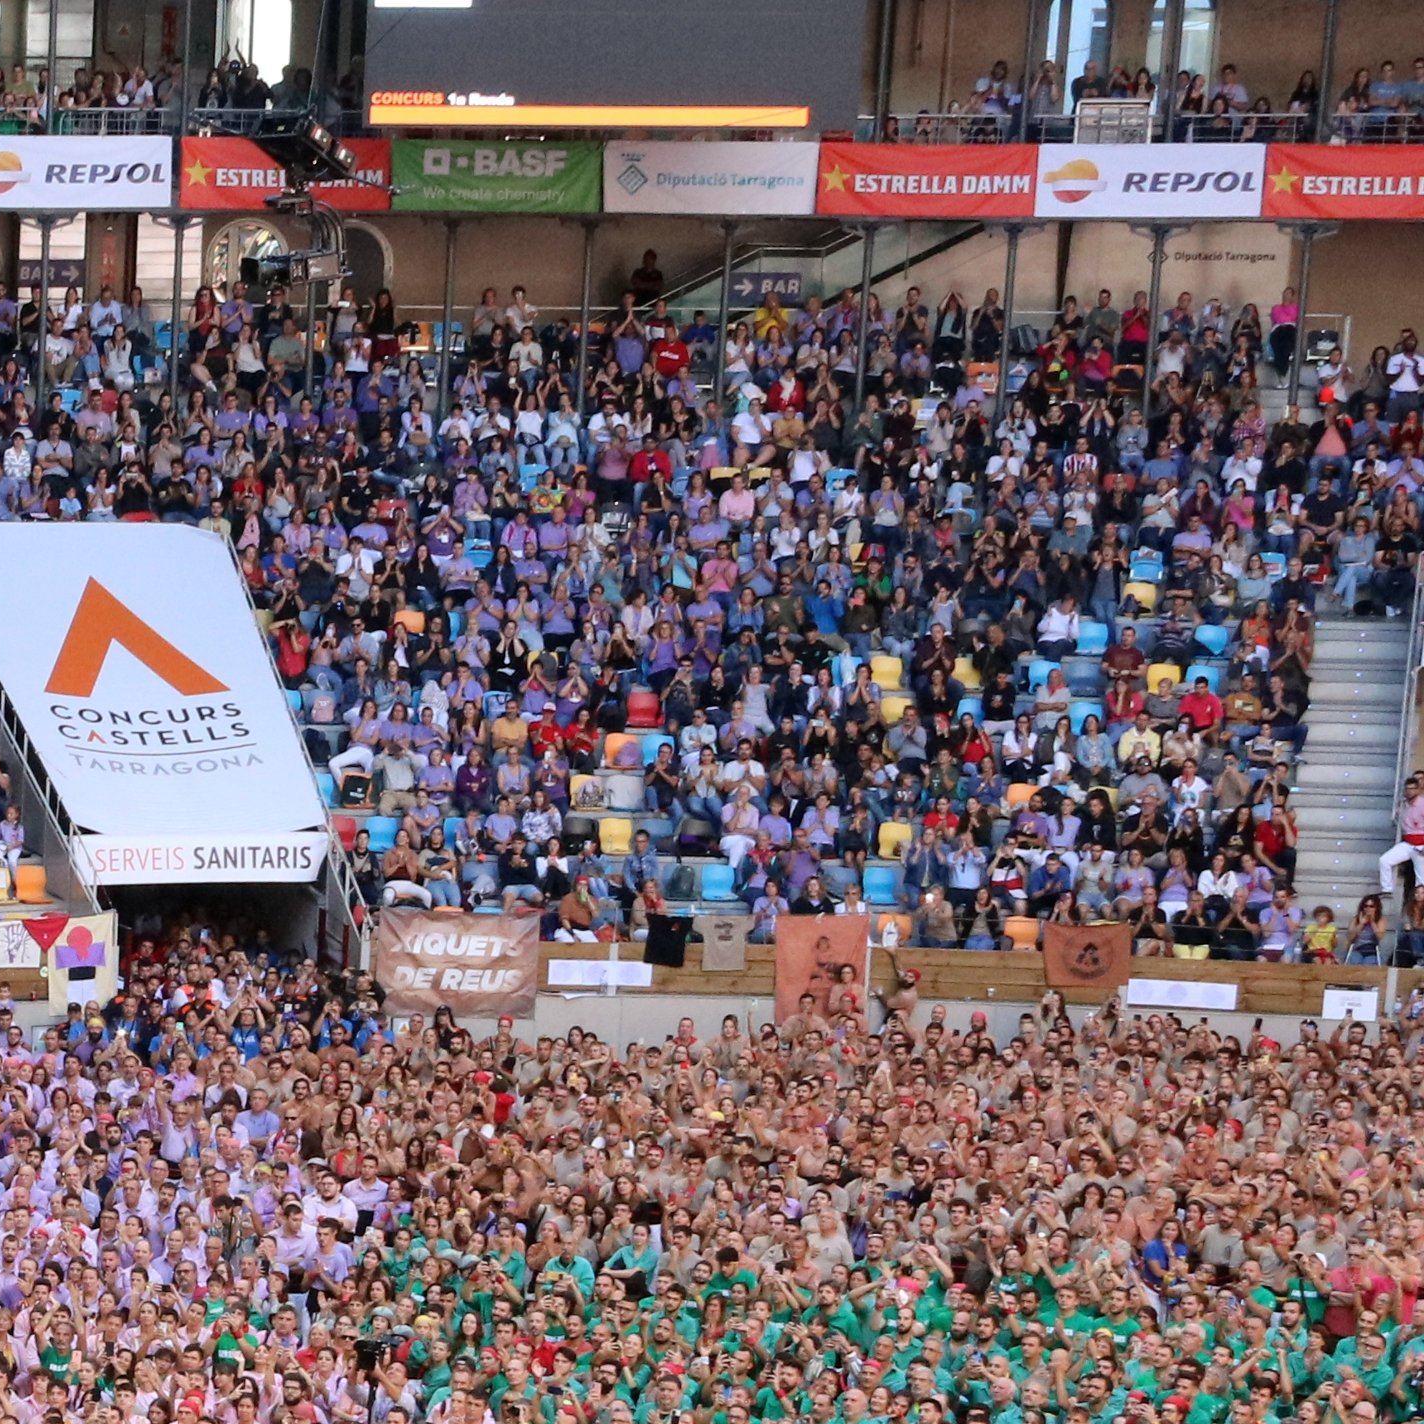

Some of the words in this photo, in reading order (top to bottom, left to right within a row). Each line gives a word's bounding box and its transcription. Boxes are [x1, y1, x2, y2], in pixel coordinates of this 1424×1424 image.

[371, 91, 444, 105] CONCURS
[473, 148, 568, 177] BASF
[45, 163, 166, 185] REPSOL
[656, 172, 728, 188] Diputació
[731, 173, 805, 190] Tarragona
[854, 172, 956, 194] ESTRELLA
[961, 173, 1031, 194] DAMM
[1122, 170, 1257, 193] REPSOL
[1303, 174, 1412, 196] ESTRELLA
[498, 187, 565, 204] chemistry
[1173, 251, 1223, 262] Diputació
[1225, 252, 1276, 263] Tarragona
[760, 278, 800, 294] BAR
[50, 702, 242, 726] CONCURS
[57, 722, 251, 746] CASTELLS
[68, 751, 264, 776] TARRAGONA
[95, 847, 186, 873] SERVEIS
[193, 846, 312, 870] SANITARIS
[393, 965, 438, 990] DE
[439, 968, 524, 991] REUS
